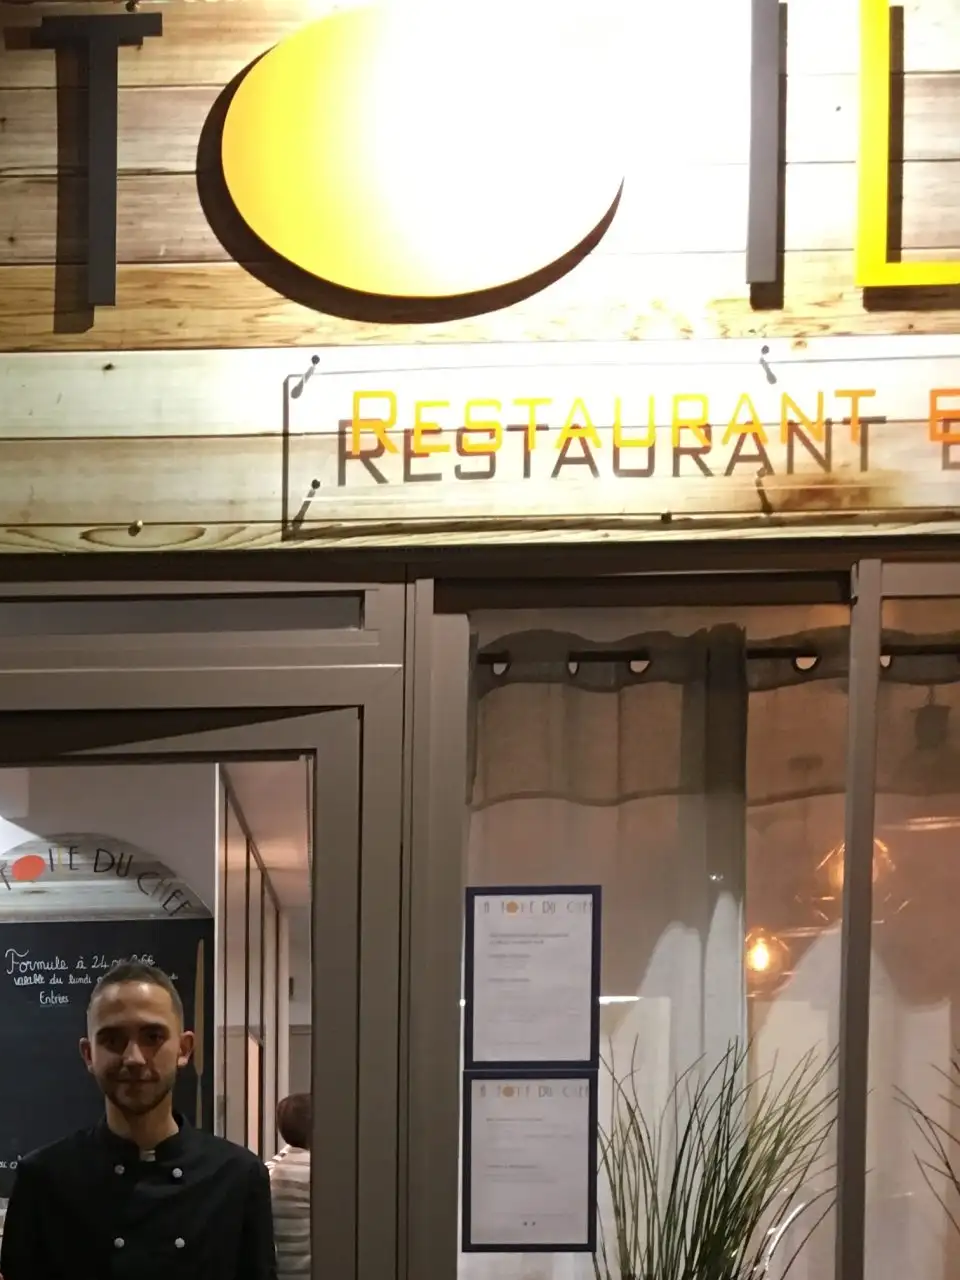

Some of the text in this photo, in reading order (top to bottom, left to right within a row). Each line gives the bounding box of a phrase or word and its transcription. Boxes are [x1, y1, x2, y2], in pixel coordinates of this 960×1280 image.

[351, 387, 877, 455] RESTAURANT
[93, 847, 134, 878] DU
[5, 948, 68, 975] Formule
[75, 955, 87, 970] à
[49, 972, 63, 985] du
[68, 973, 92, 985] lundi
